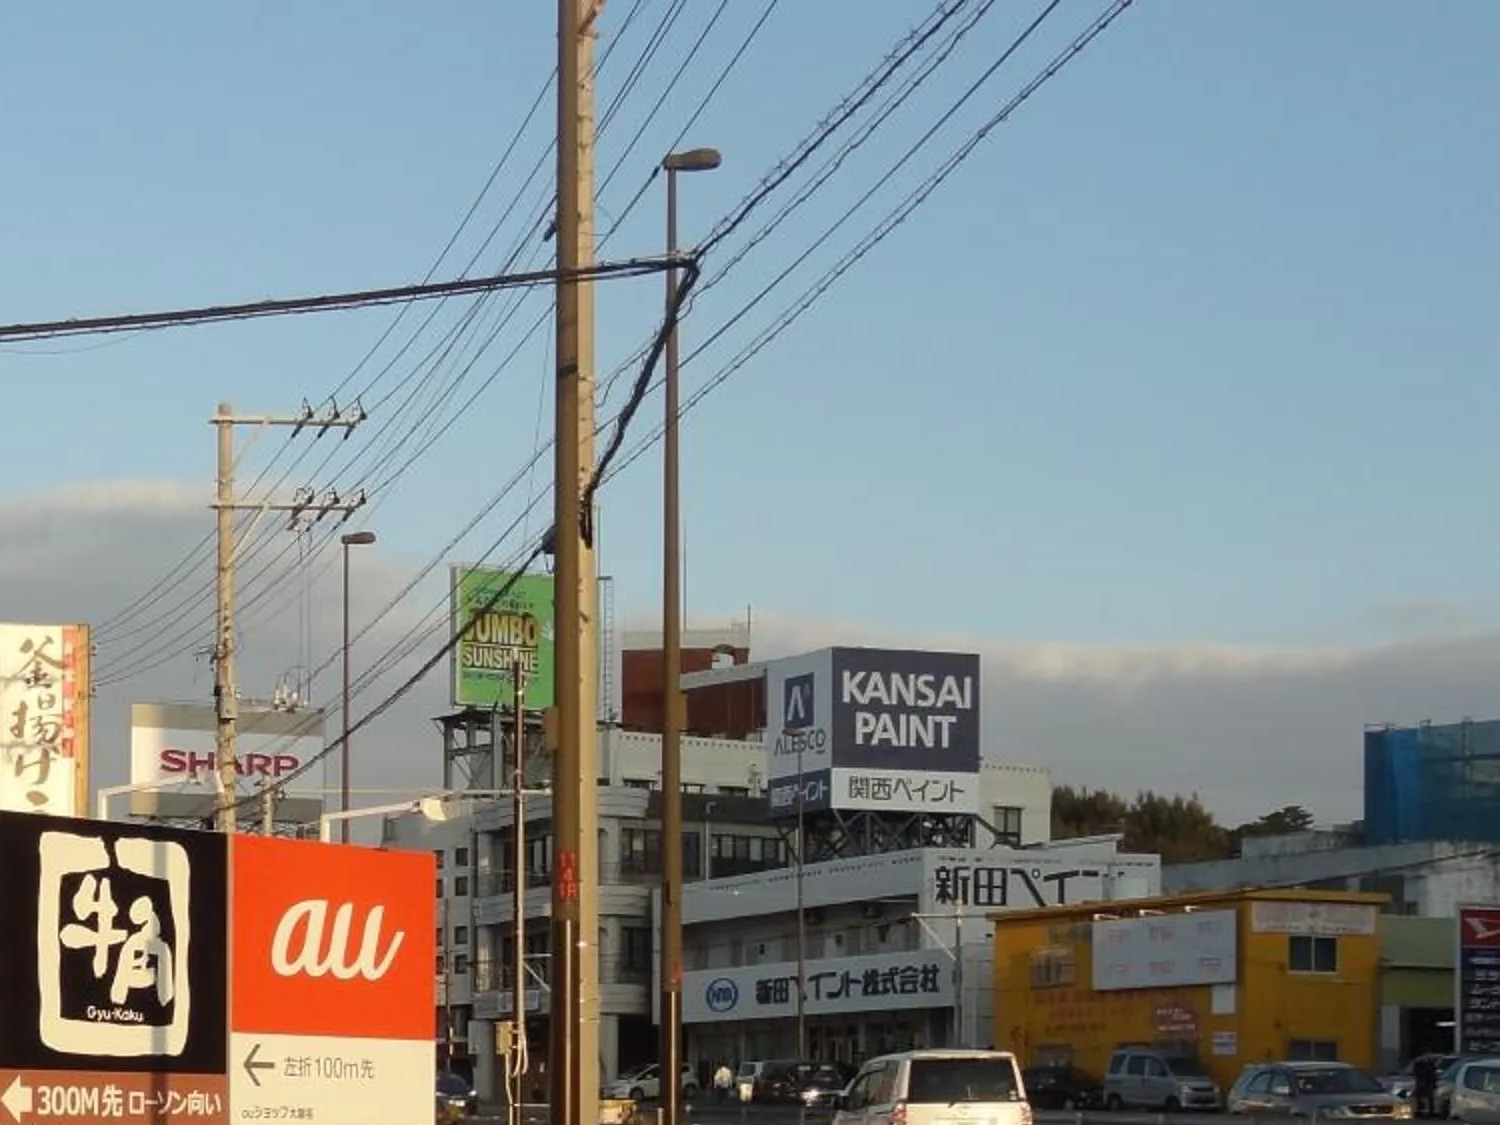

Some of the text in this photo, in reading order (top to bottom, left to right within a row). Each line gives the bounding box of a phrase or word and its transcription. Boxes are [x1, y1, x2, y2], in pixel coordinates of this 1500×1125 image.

[461, 645, 539, 673] SUNSHNE
[841, 669, 973, 710] KANSAI
[9, 634, 65, 813] 釜揚げ
[854, 711, 958, 748] PAINT
[848, 774, 966, 802] 関西ペイント
[934, 865, 1125, 908] 新田ペイ
[59, 873, 174, 1007] 牛角
[270, 899, 405, 981] au
[86, 1005, 145, 1022] Gyu-Kaku
[283, 1055, 375, 1080] 左折100m先
[37, 1084, 222, 1117] 300M先 ローソン向い
